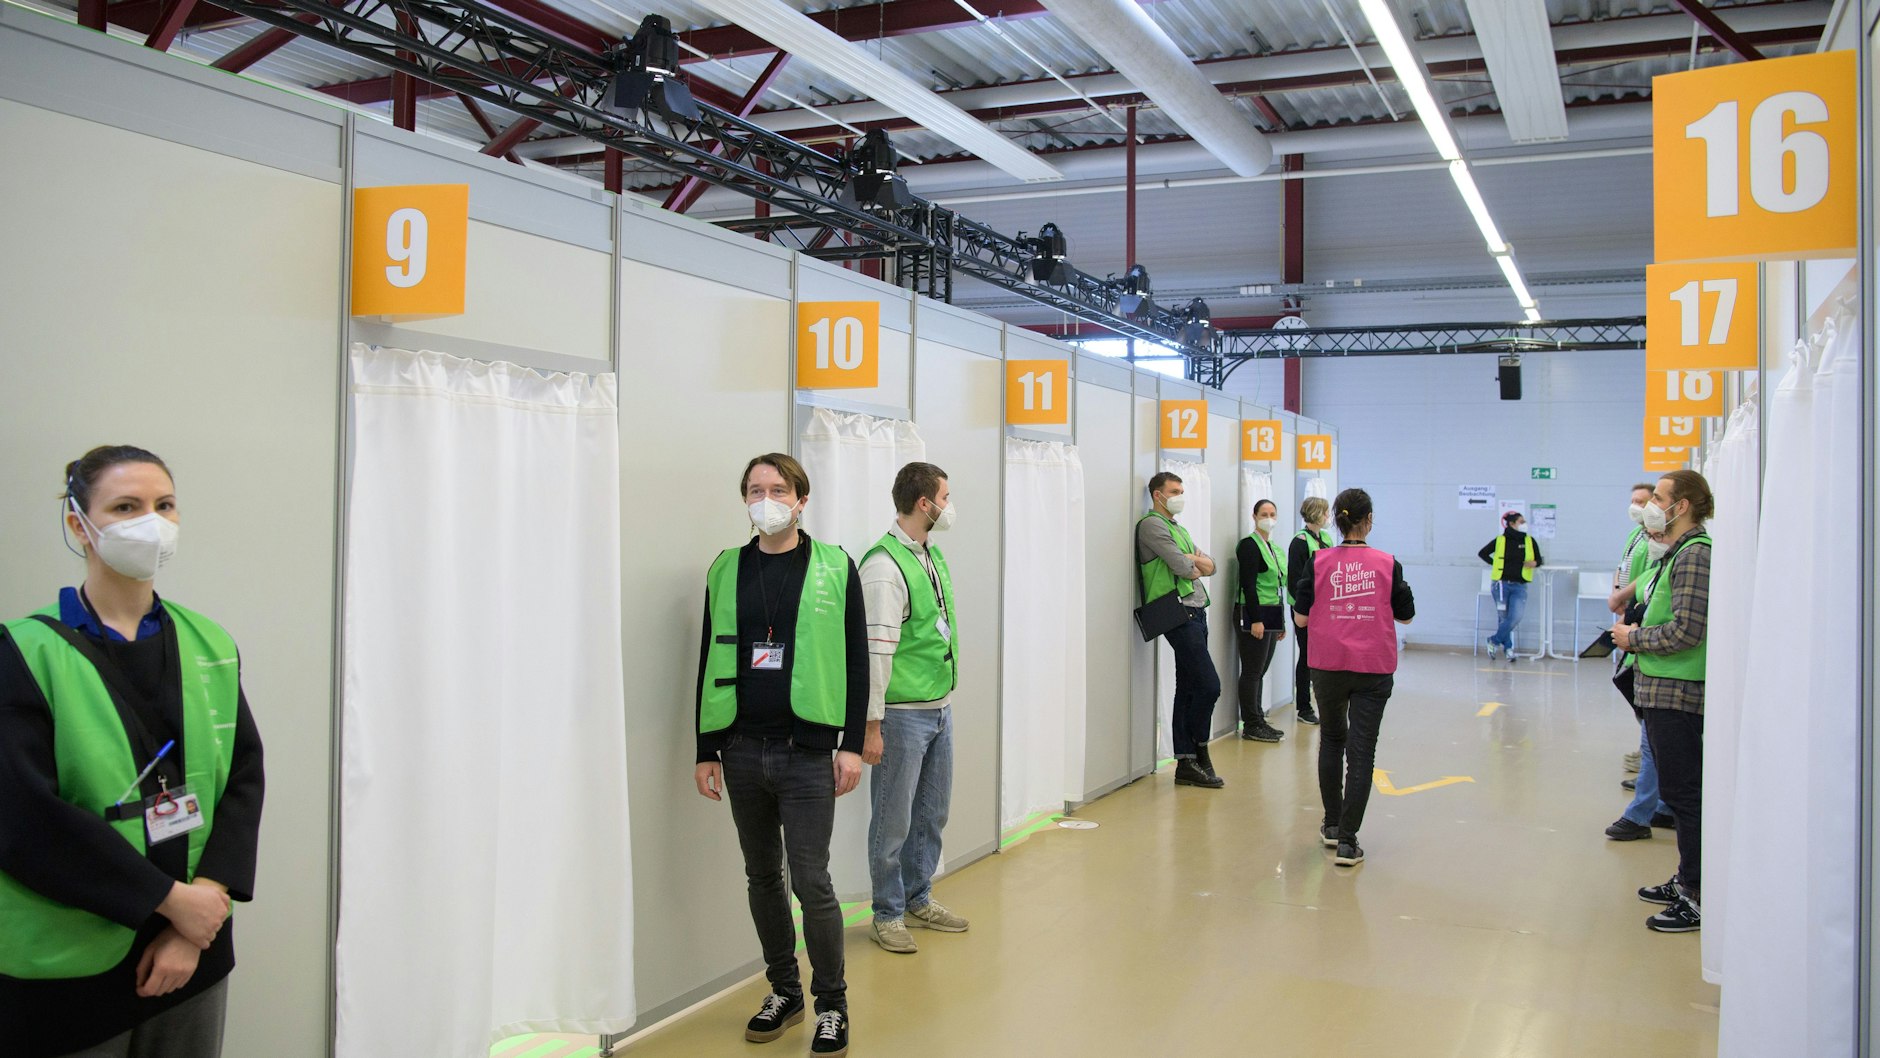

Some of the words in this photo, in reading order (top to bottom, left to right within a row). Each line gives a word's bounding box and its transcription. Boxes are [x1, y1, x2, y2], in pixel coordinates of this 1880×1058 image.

[1686, 91, 1830, 217] 16
[385, 208, 428, 288] 9
[1669, 278, 1738, 346] 17
[809, 317, 864, 370] 10
[1017, 372, 1053, 411] 11
[1168, 408, 1199, 439] 12
[1247, 427, 1275, 453] 13
[1302, 440, 1327, 464] 14
[1345, 561, 1362, 572] Wir
[1345, 570, 1376, 582] helfen
[1345, 579, 1375, 593] Berlin
